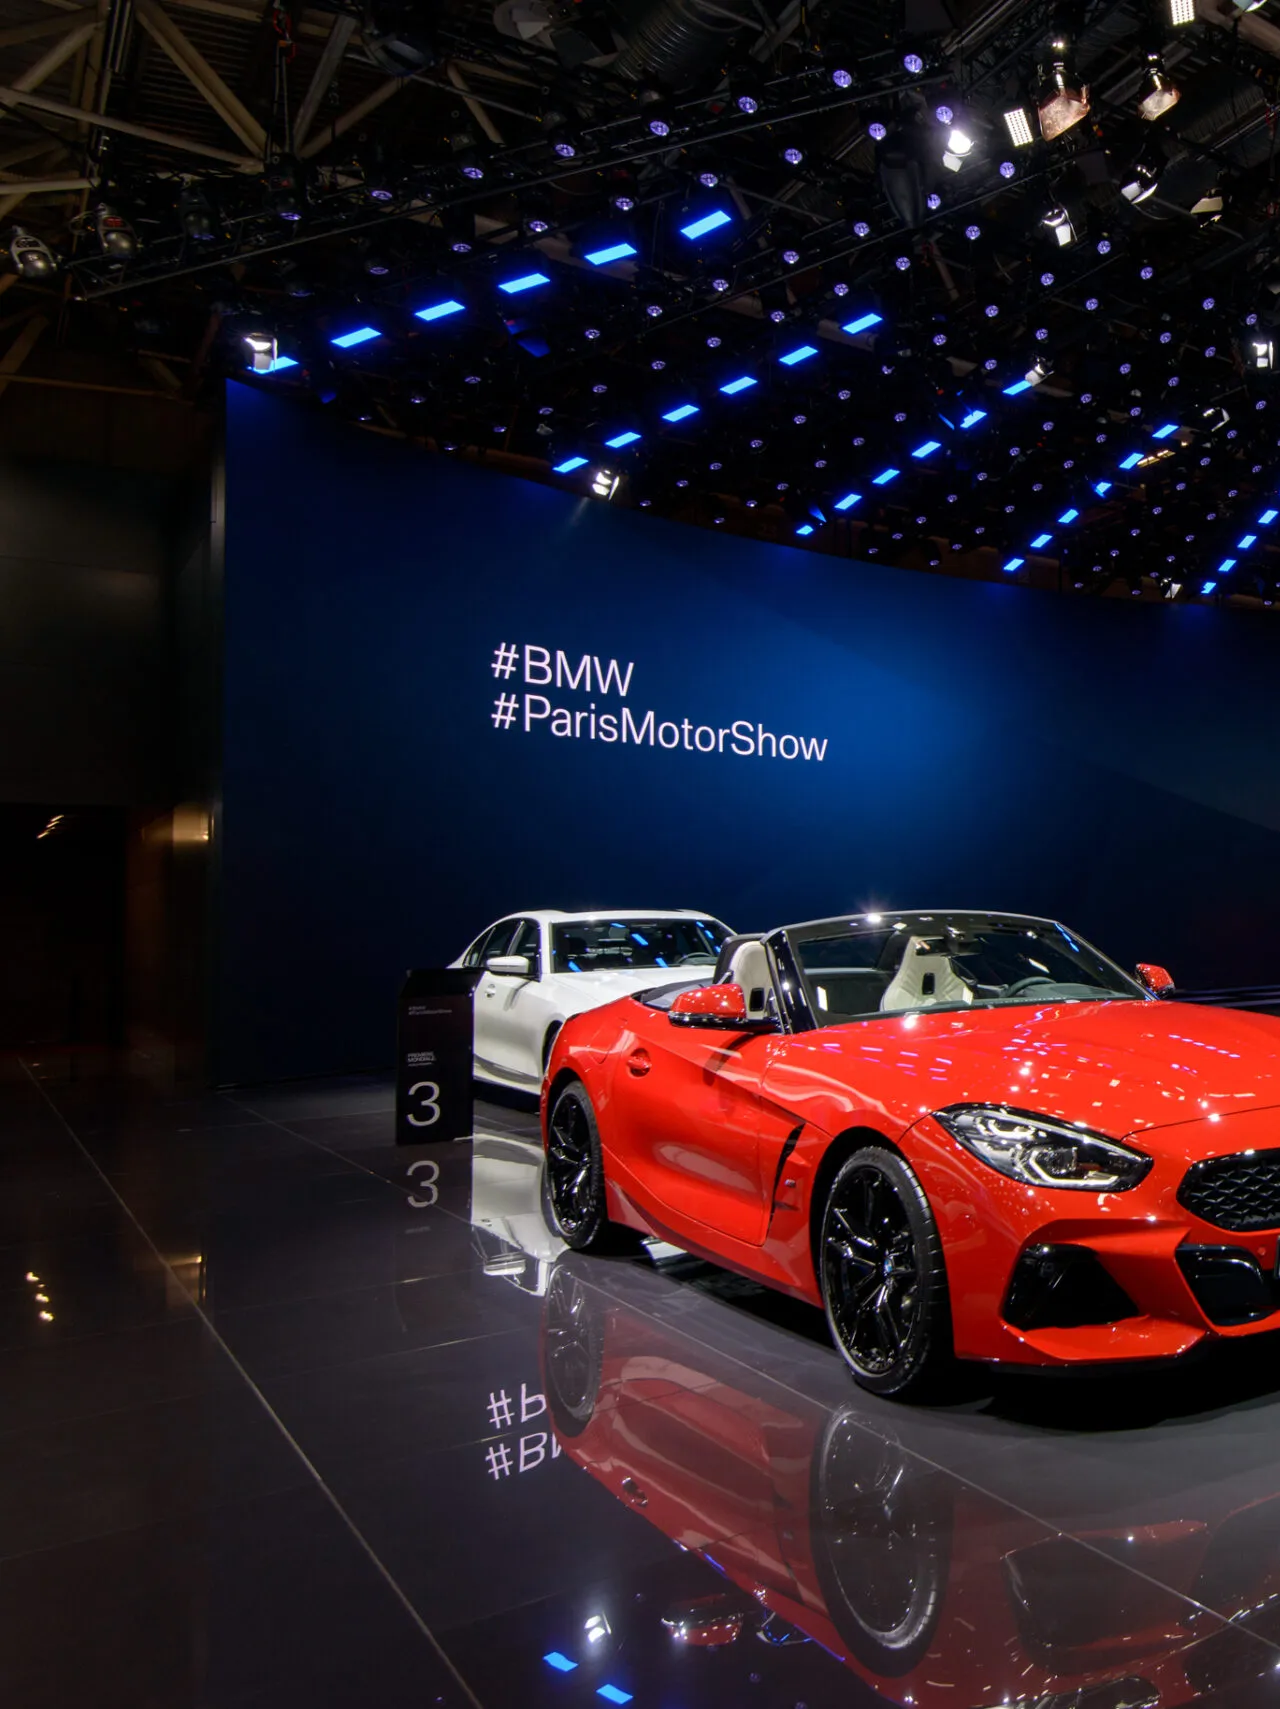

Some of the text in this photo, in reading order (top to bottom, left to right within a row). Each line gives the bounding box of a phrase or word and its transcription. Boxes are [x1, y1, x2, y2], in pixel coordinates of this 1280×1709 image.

[491, 642, 634, 697] #BMW
[491, 692, 828, 761] #ParisMotorShow
[406, 1081, 441, 1127] 3
